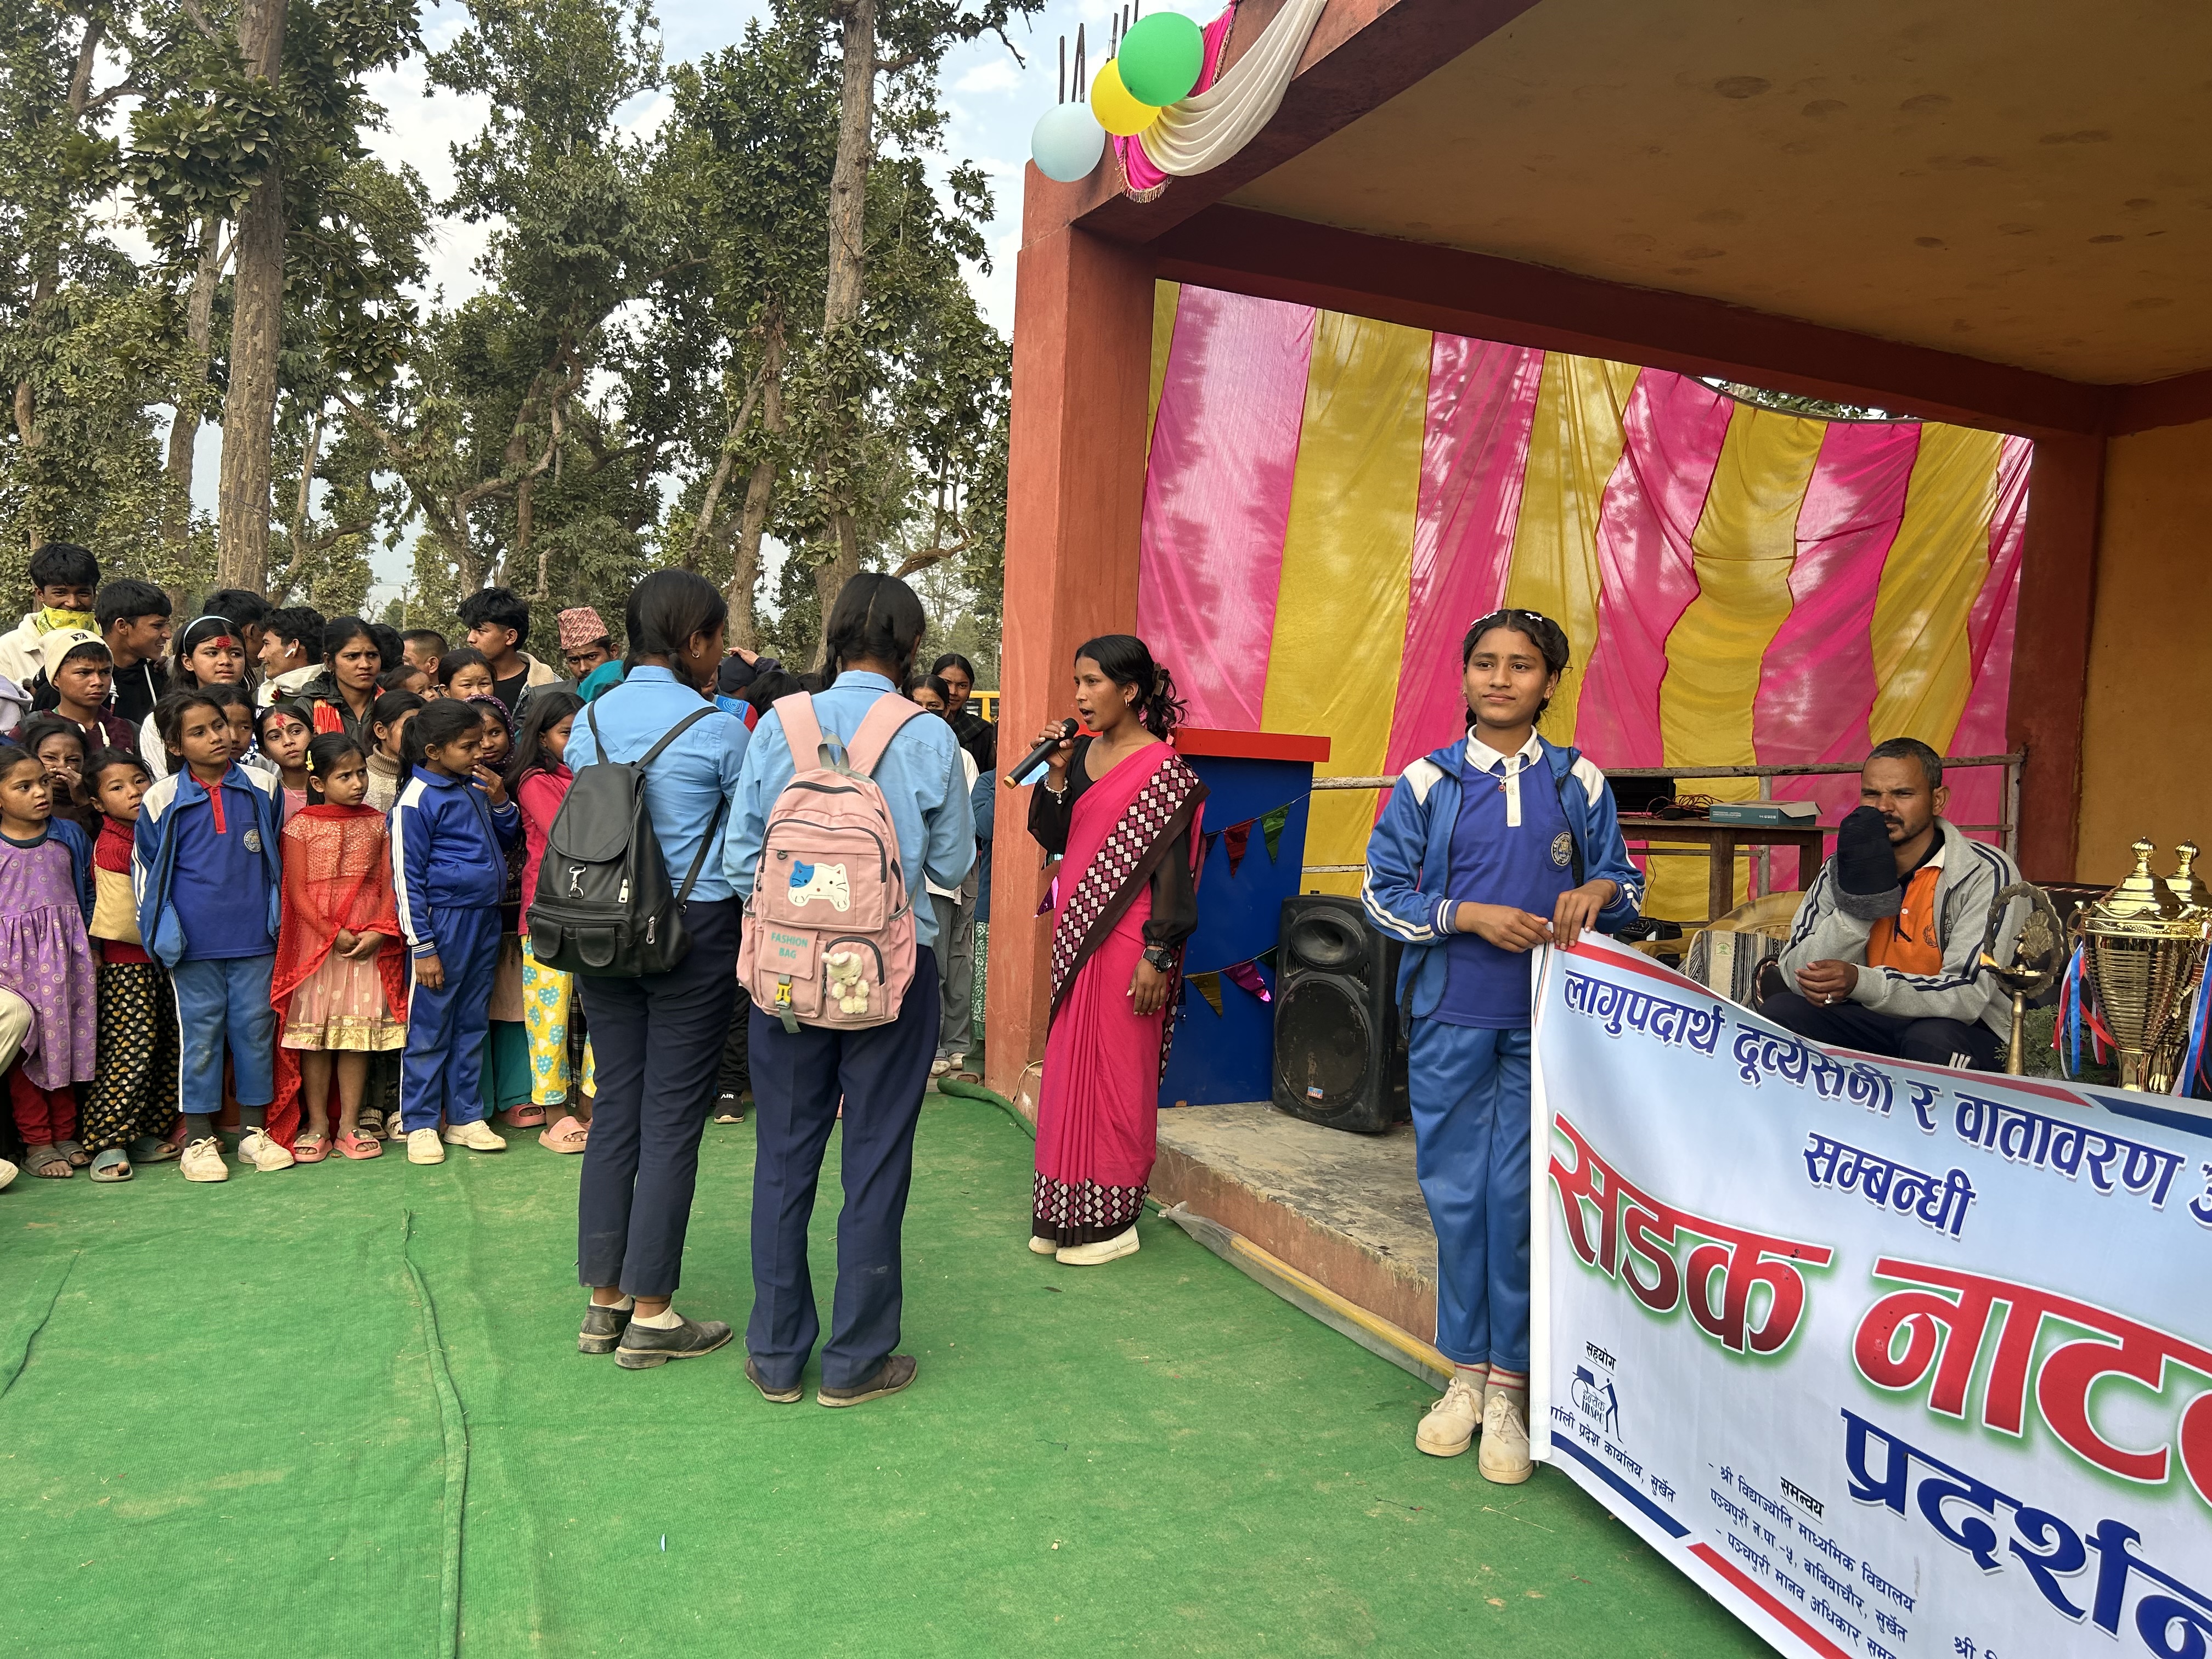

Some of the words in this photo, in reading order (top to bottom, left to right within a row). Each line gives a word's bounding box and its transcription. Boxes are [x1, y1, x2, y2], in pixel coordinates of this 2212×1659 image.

[771, 931, 809, 948] FASHION
[778, 947, 797, 959] BAG
[1564, 968, 1726, 1056] लागुपदार्थ
[1905, 1079, 1940, 1131] र
[1954, 1091, 2186, 1207] वातावरण
[1803, 1131, 1977, 1237] सम्बन्धी
[1548, 1111, 1834, 1355] सडक
[1586, 1340, 1617, 1371] सहयोग
[1581, 1395, 1605, 1425] insec
[1579, 1422, 1601, 1448] प्रदेश
[1604, 1440, 1644, 1484] कार्यालय,
[1651, 1474, 1676, 1503] सुर्खेत
[1780, 1475, 1825, 1519] समन्वय
[1720, 1465, 1734, 1487] श्री
[1798, 1521, 1857, 1572] माध्यमिक
[1861, 1561, 1917, 1613] विद्यालय
[1775, 1567, 1805, 1602] मानव
[1810, 1595, 1862, 1647] अधिकार
[1866, 1636, 1897, 1659] सम
[1875, 1608, 1908, 1644] सुर्खेत
